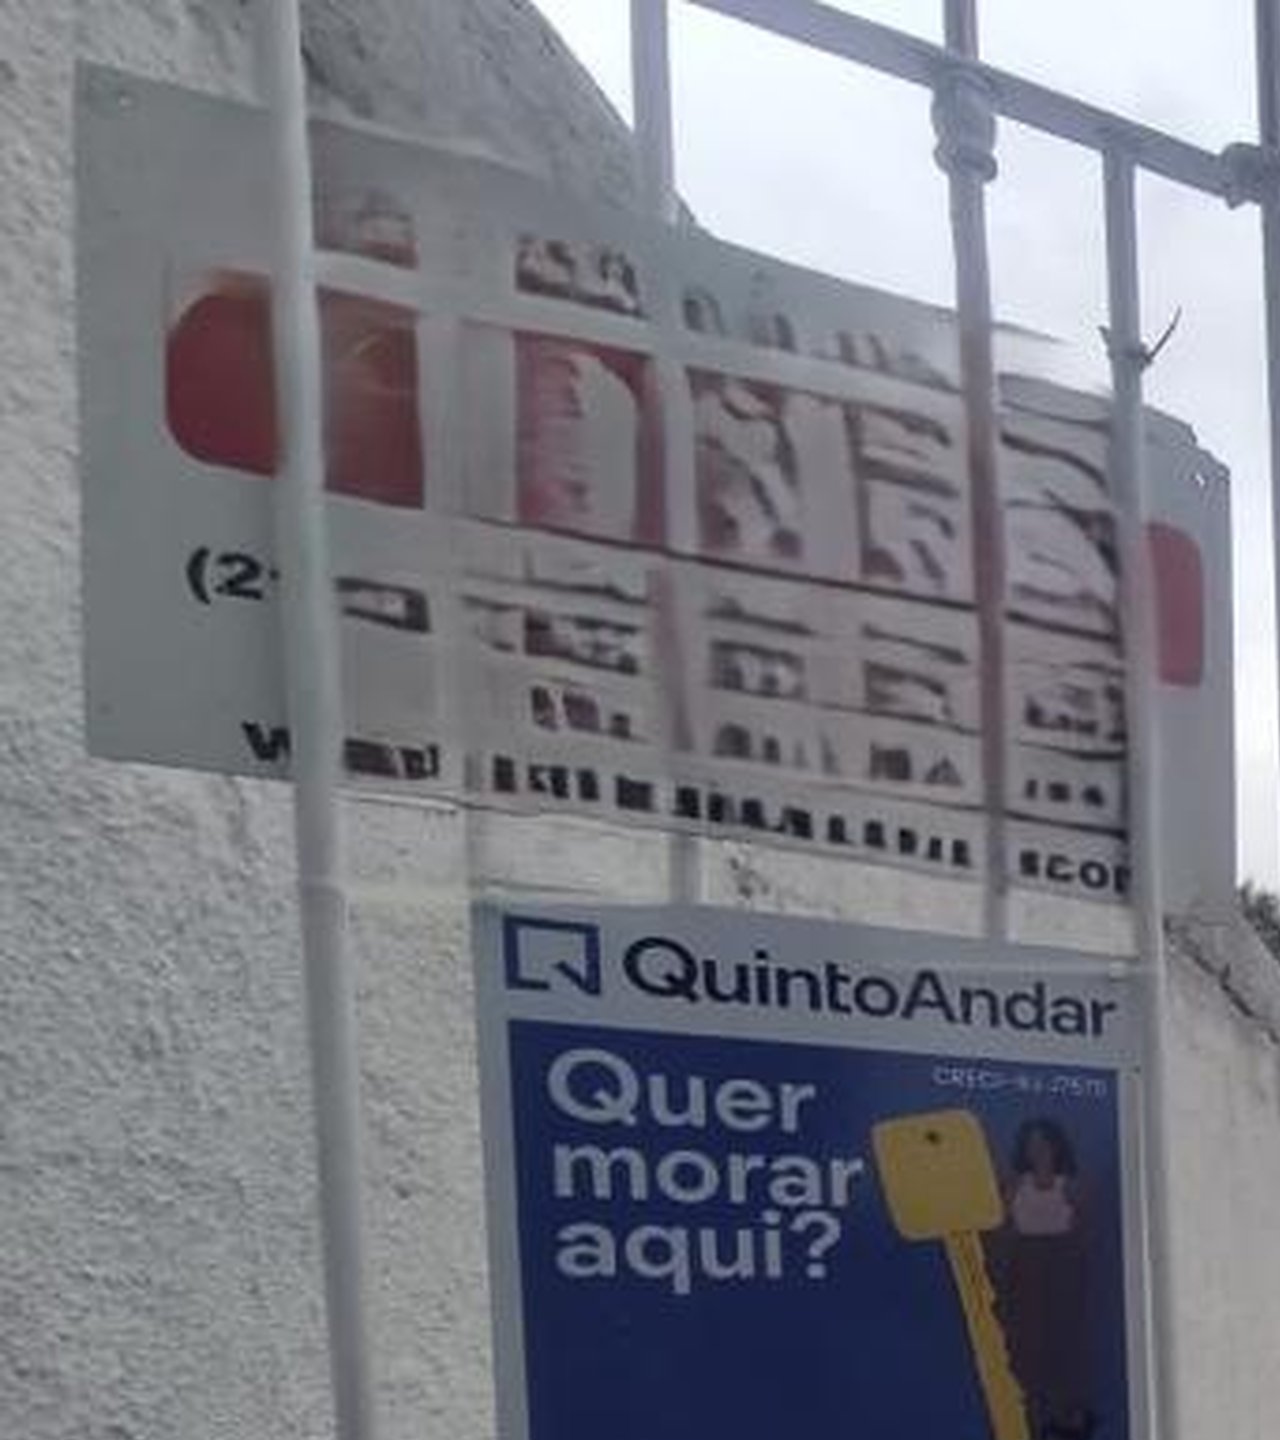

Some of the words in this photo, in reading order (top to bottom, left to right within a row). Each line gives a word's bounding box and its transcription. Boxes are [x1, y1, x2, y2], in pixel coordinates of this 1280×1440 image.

[622, 937, 1117, 1037] QuintoAndar
[547, 1048, 815, 1133] Quer
[553, 1143, 865, 1208] morar
[556, 1210, 842, 1295] aqui?
